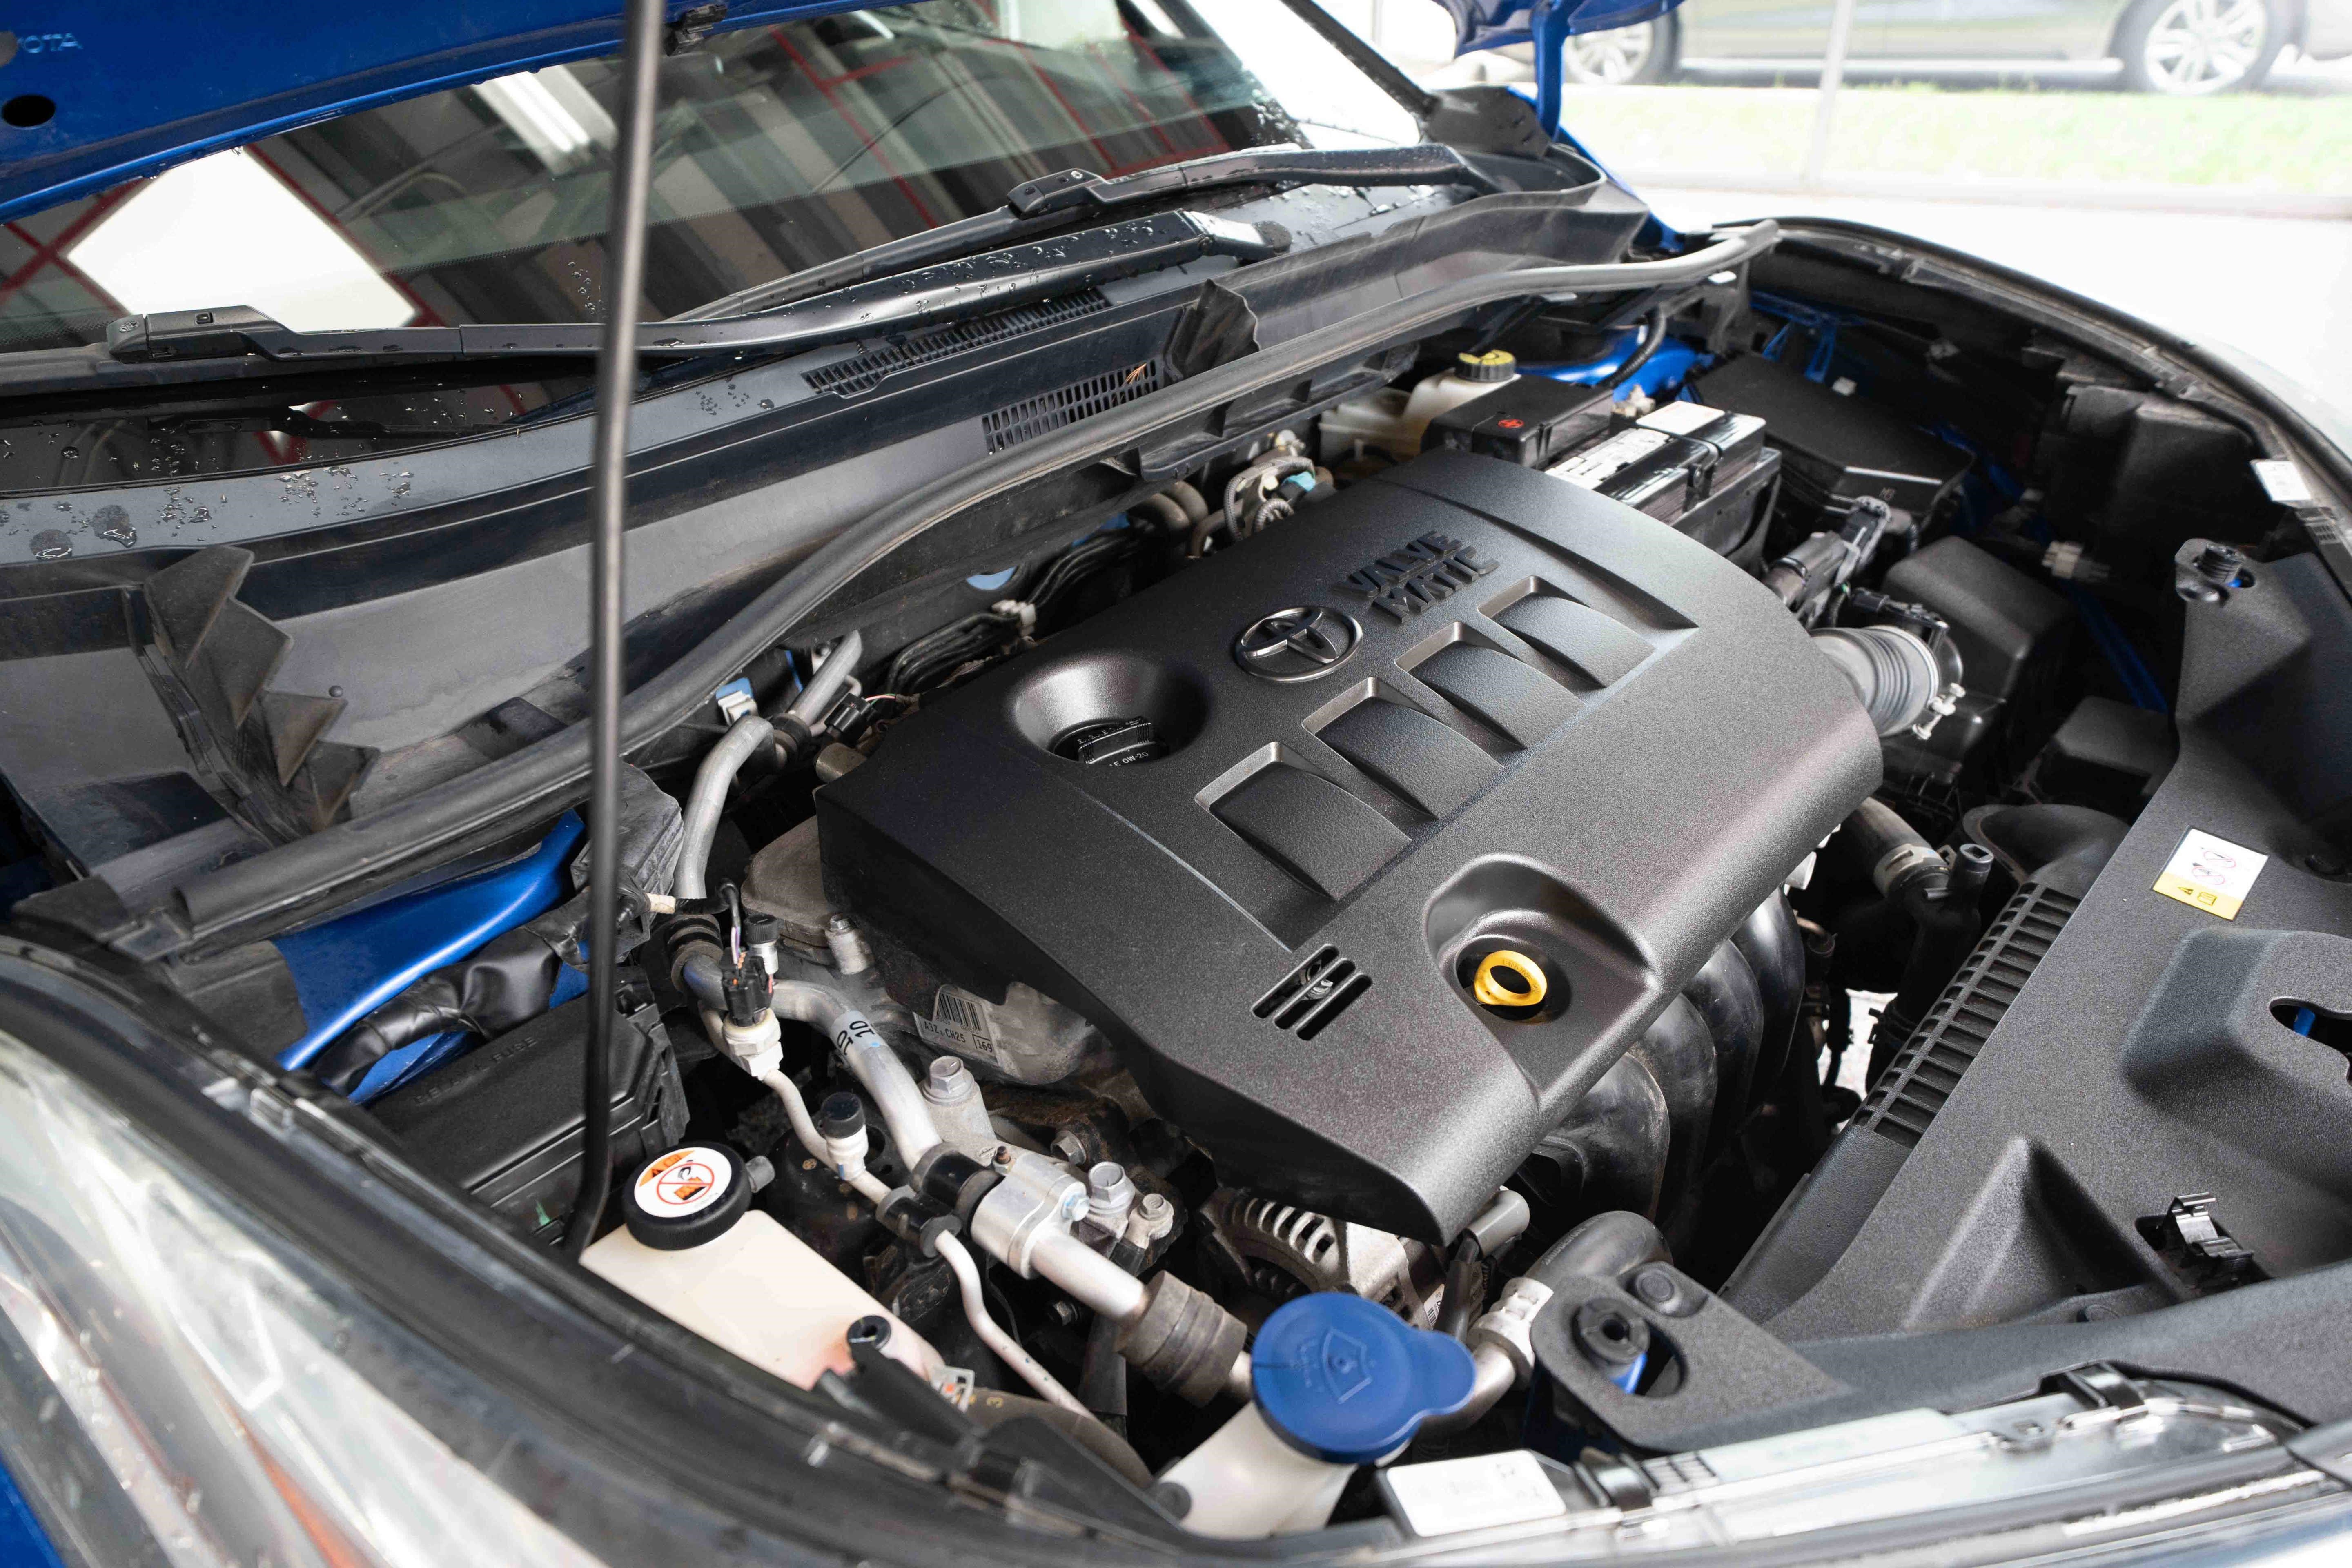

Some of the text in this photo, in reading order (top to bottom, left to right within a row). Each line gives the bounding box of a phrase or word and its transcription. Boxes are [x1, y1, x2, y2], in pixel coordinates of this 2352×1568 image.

[1332, 531, 1463, 598] VALVE
[1371, 545, 1500, 624] MATIC
[1122, 752, 1149, 764] 0W-20
